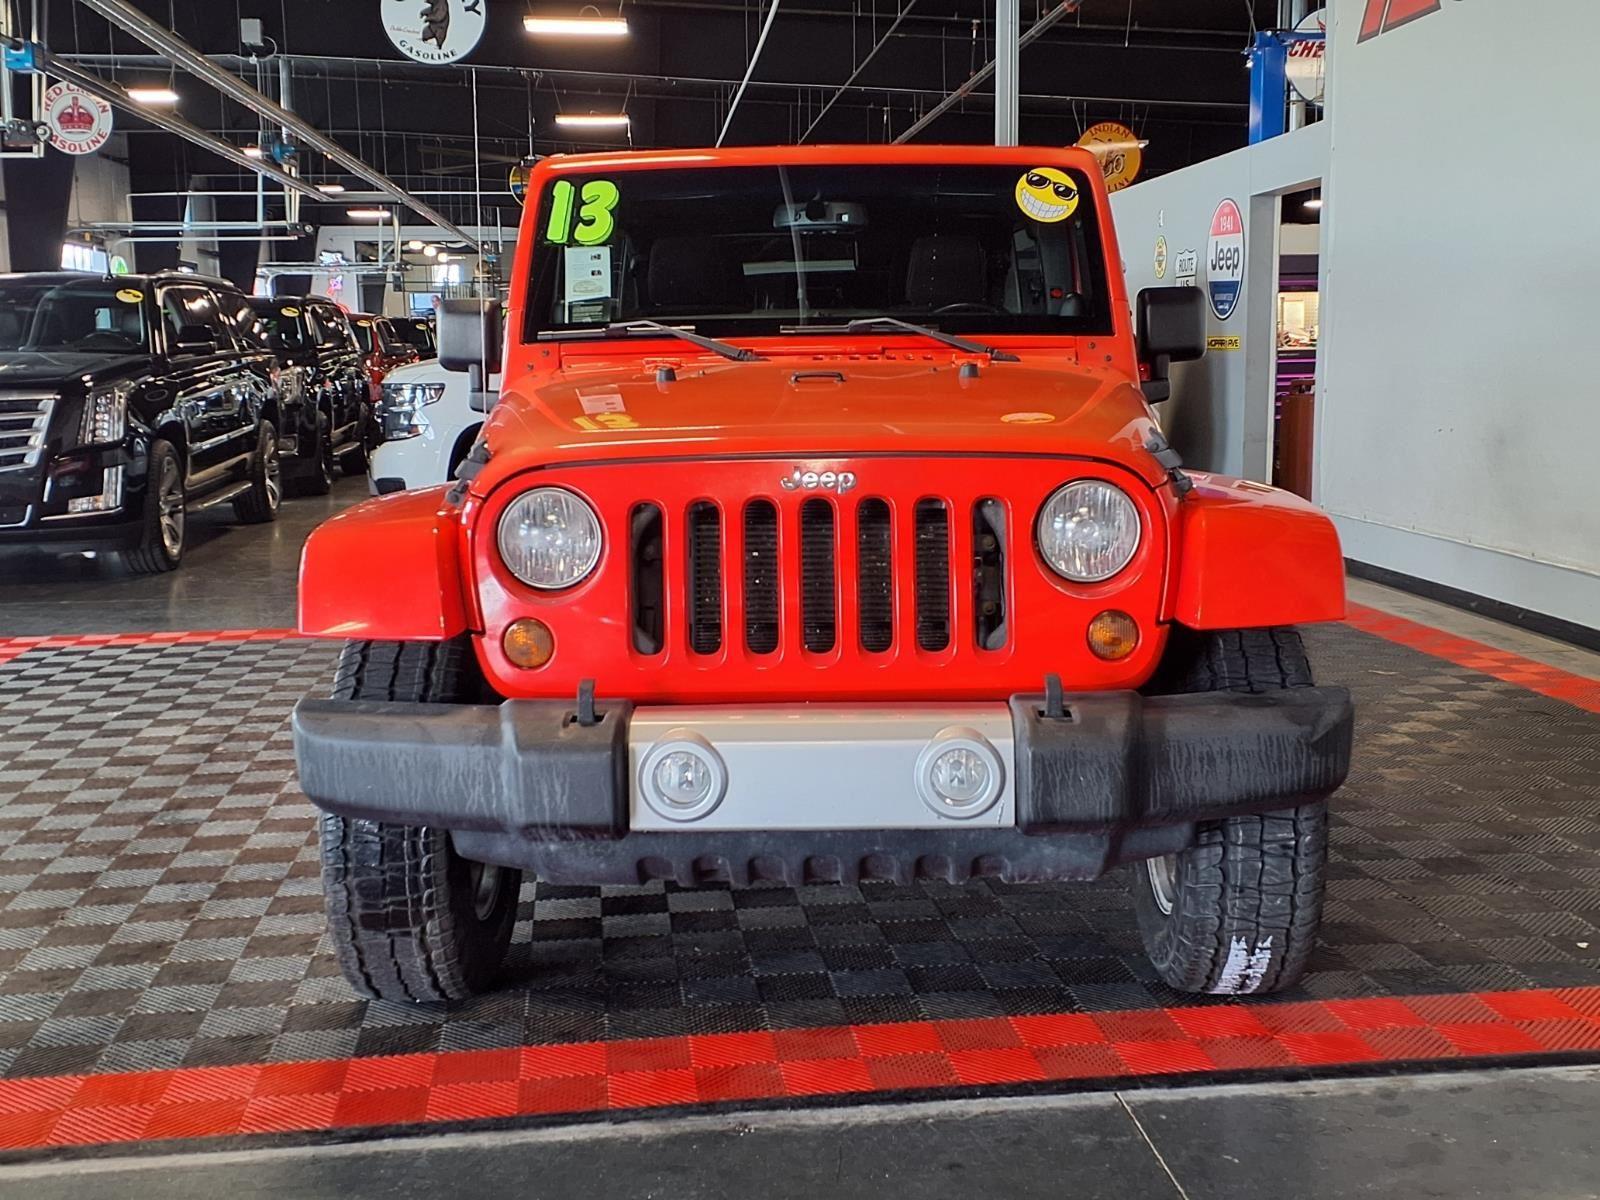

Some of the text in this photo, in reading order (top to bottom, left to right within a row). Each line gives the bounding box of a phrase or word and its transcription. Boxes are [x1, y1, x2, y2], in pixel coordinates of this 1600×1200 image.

[399, 39, 457, 60] GASOLINE
[50, 128, 108, 153] ASOLINE
[1089, 124, 1130, 139] INDIAN
[546, 180, 619, 245] 13
[1220, 216, 1233, 231] 1941
[1179, 257, 1194, 273] ROUTE
[1211, 241, 1240, 277] Jeep
[780, 466, 857, 494] Jeep
